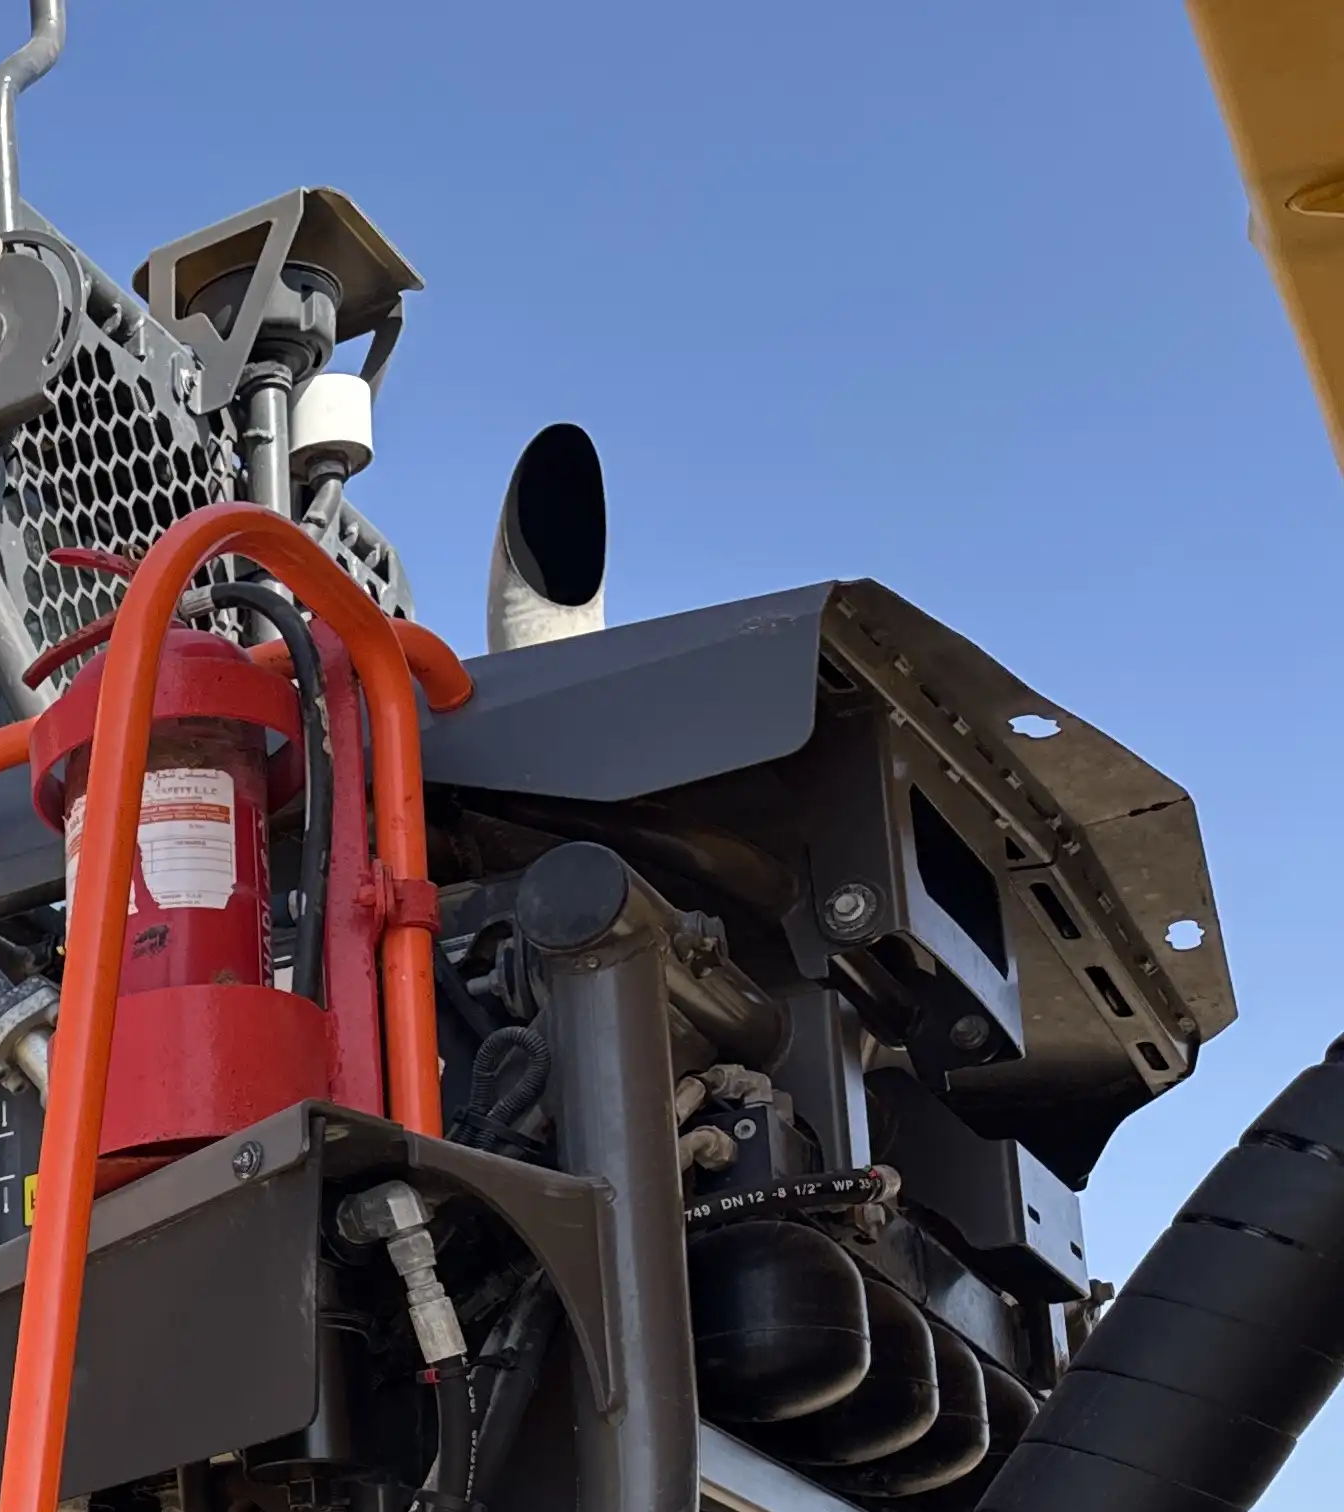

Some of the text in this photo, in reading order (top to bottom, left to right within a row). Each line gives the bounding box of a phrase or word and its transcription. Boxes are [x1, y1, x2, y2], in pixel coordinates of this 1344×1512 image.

[720, 1194, 744, 1211] DN
[747, 1190, 765, 1205] 12
[832, 1179, 854, 1192] WP
